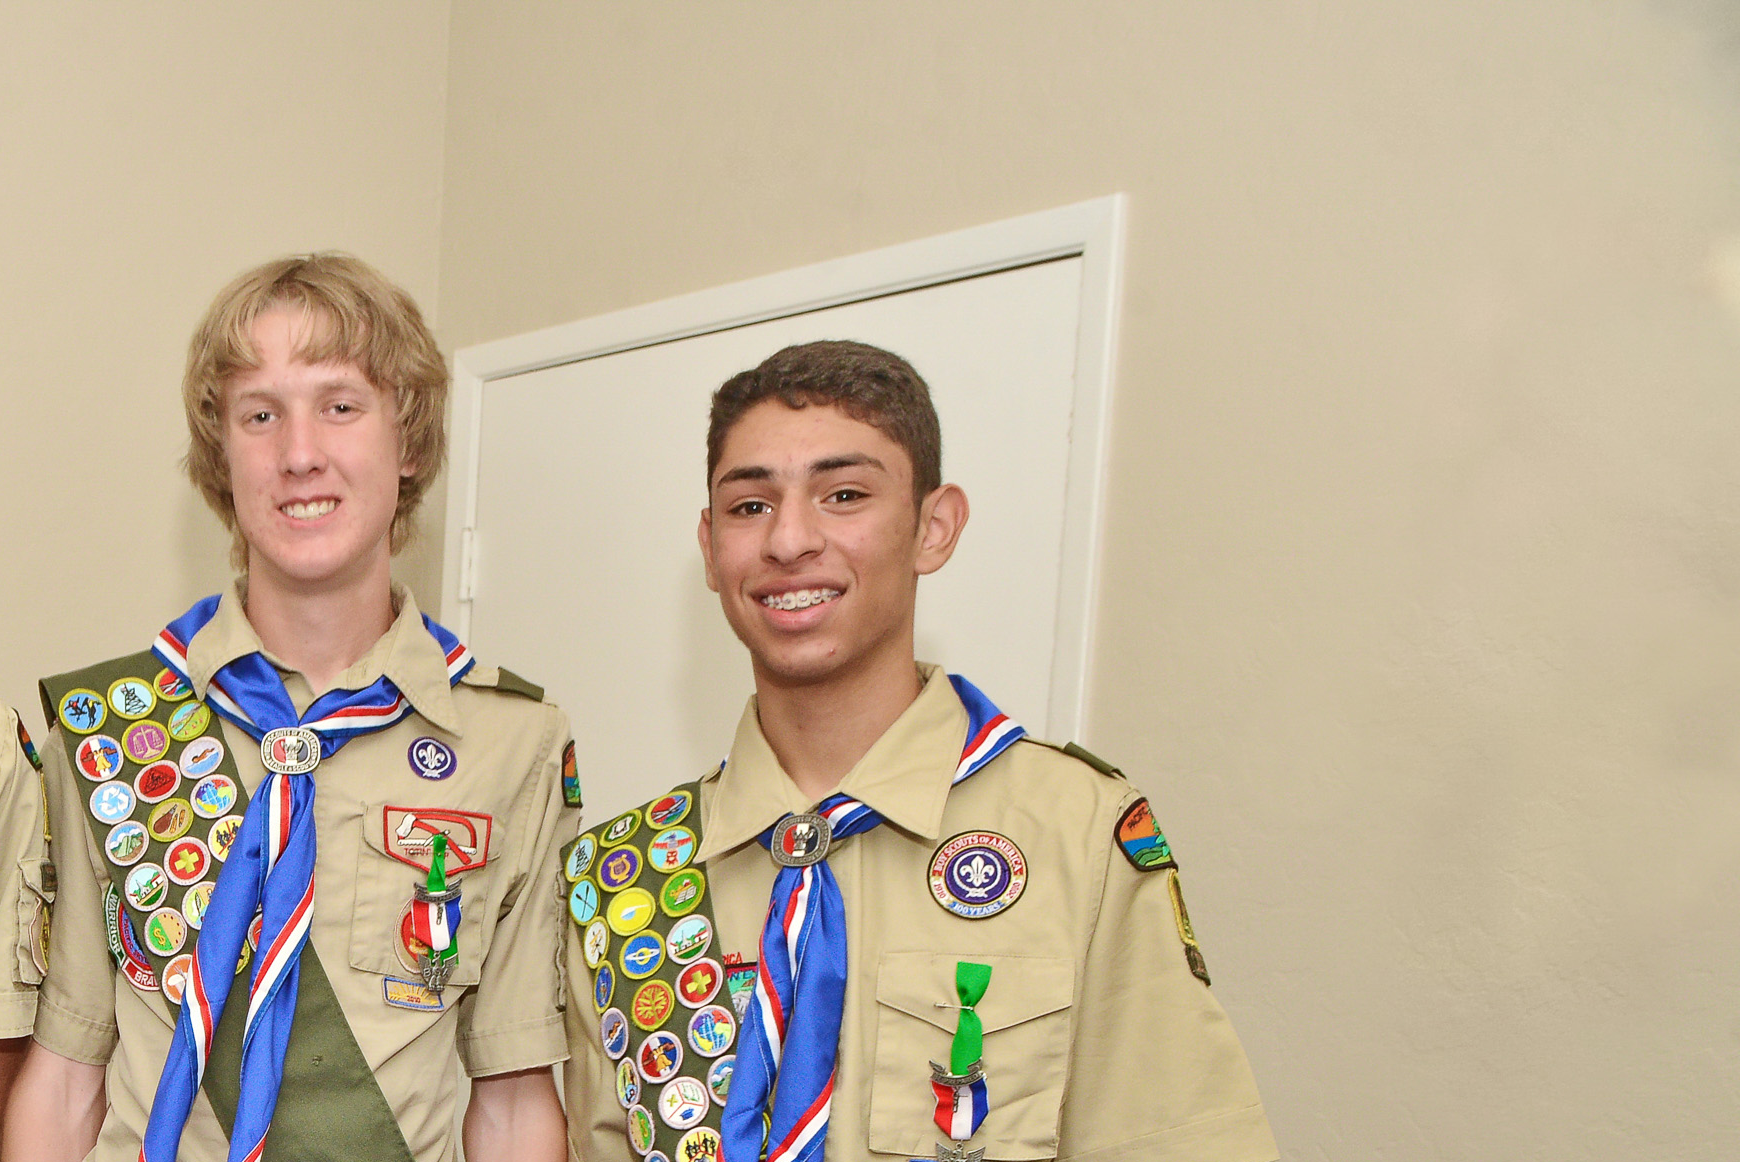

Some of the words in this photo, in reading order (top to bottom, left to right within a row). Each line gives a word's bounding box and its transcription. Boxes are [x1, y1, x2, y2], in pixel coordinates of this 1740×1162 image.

[934, 852, 948, 871] BOY
[945, 835, 979, 857] SCOUTS
[989, 837, 1023, 872] AMERICA
[933, 882, 947, 899] 1910
[953, 901, 969, 914] 100
[969, 902, 1001, 915] YEARS
[108, 893, 121, 954] WARRIOR
